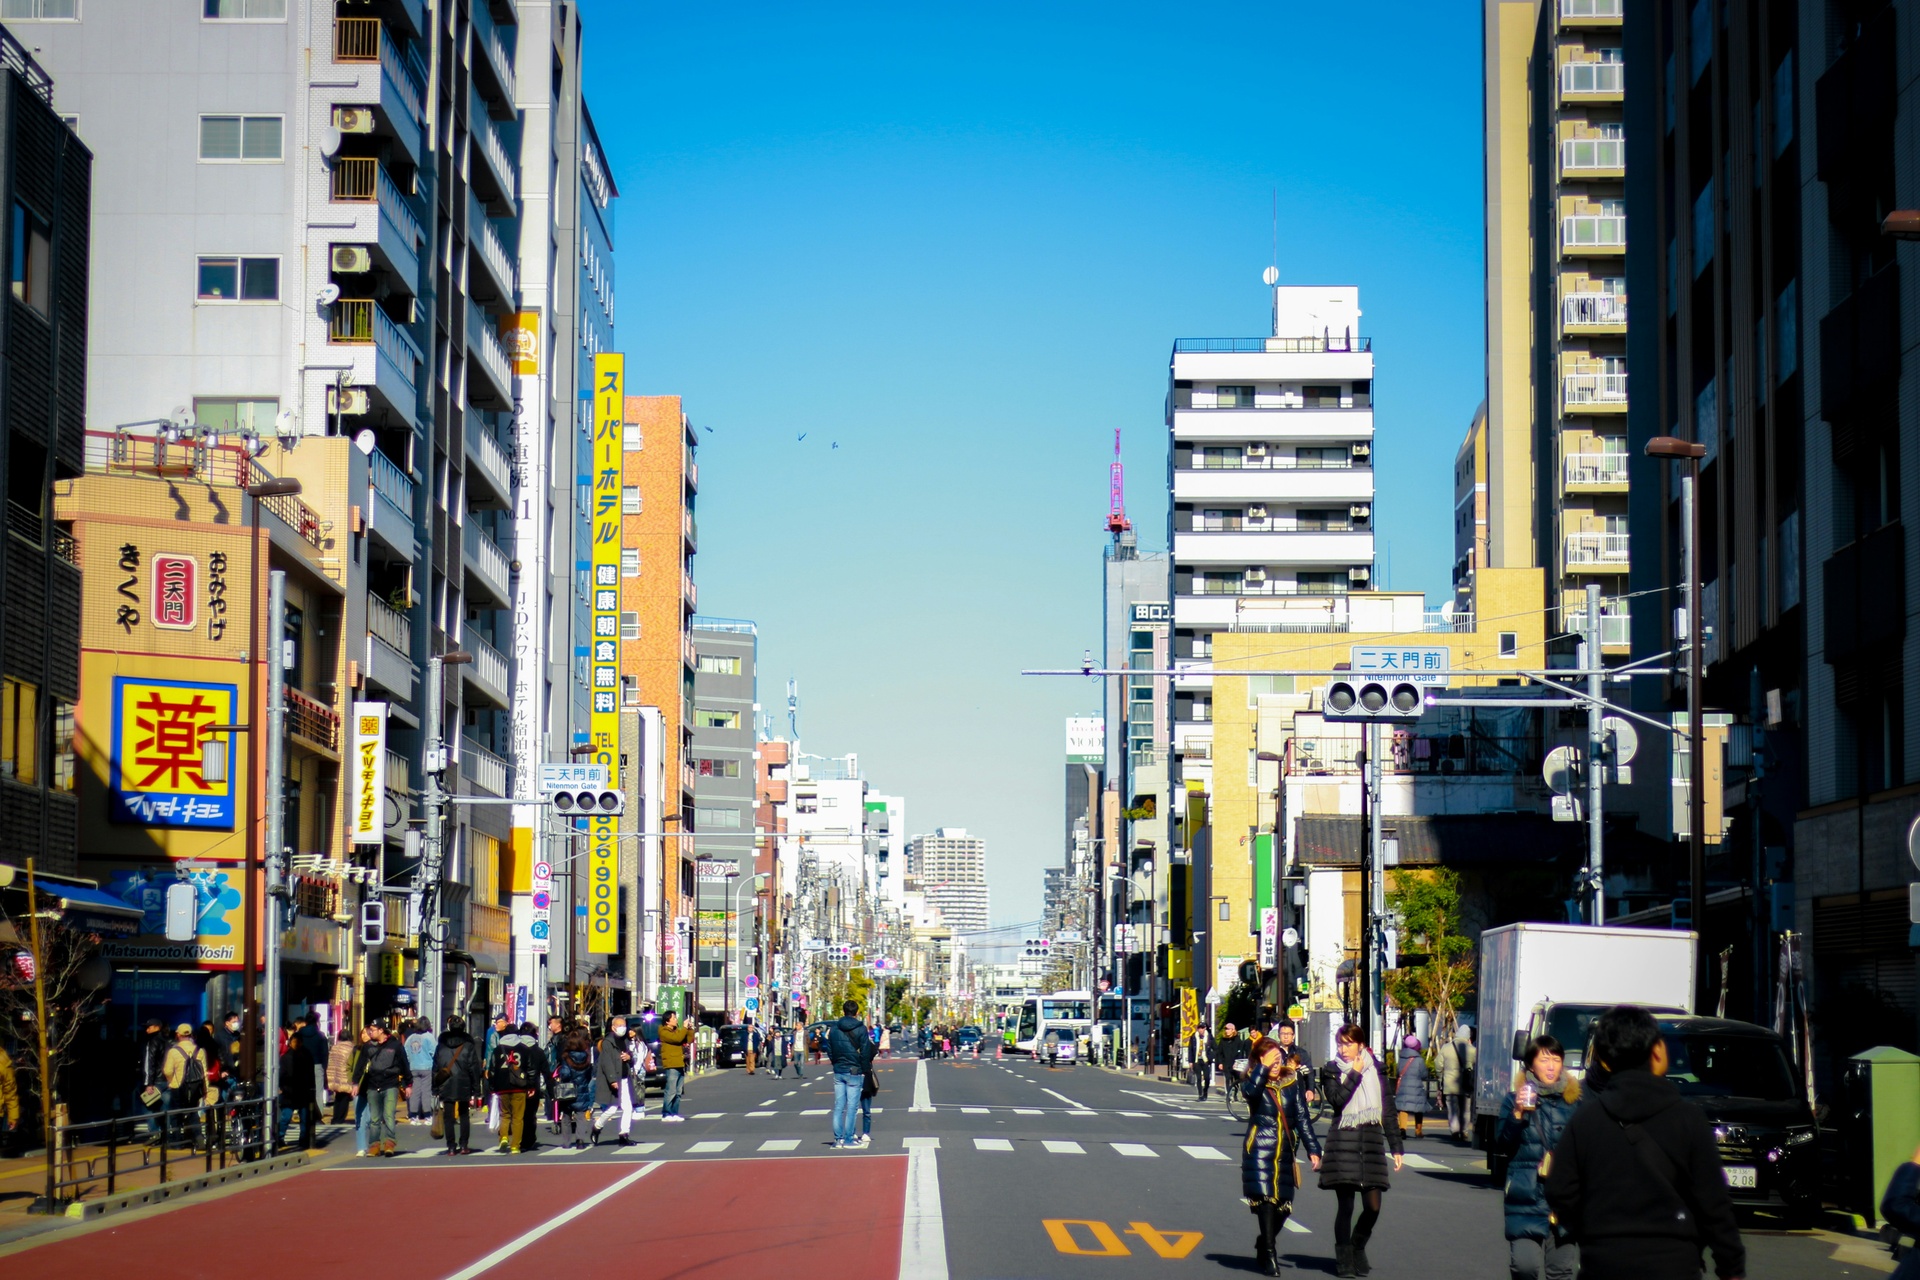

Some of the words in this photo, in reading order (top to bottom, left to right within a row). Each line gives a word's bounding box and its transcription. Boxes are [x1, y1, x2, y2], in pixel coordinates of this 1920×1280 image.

[595, 371, 620, 545] スーパーホテル
[116, 542, 141, 635] きくや
[163, 561, 185, 622] 二天門
[207, 550, 227, 641] おみやげ
[594, 565, 618, 713] 健康朝食無料
[1359, 652, 1442, 669] 二天門前
[135, 691, 217, 791] 薬
[595, 733, 614, 748] TEL
[360, 740, 378, 832] マツモトキヨシ
[543, 768, 601, 782] 二天門前
[546, 782, 579, 790] Nitenmon
[581, 782, 597, 790] Gate
[124, 794, 223, 823] マツモトキヨシ
[101, 944, 182, 958] Matsumoto
